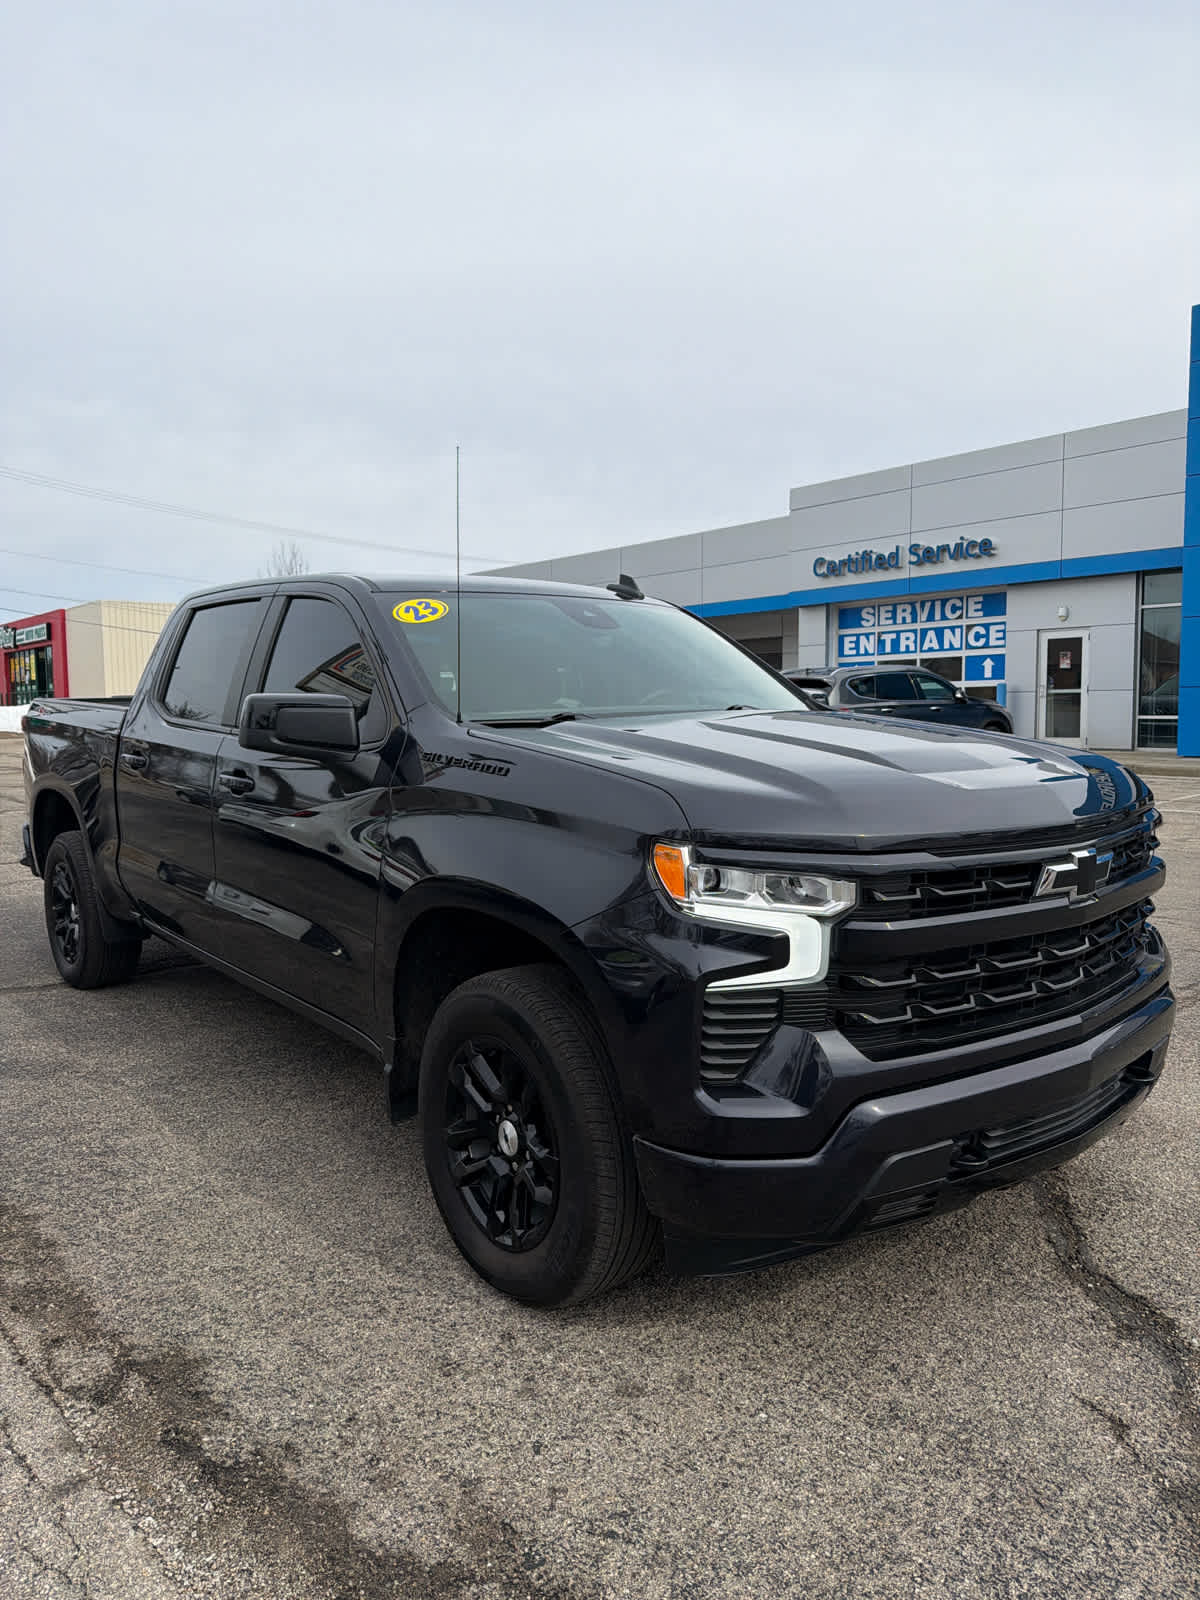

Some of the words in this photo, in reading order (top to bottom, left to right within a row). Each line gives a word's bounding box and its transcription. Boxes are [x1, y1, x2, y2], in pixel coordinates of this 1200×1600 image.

[813, 545, 900, 578] Certified
[908, 536, 993, 566] Service
[404, 600, 439, 621] 23
[860, 596, 984, 628] SERVICE
[843, 624, 1006, 656] ENTRANCE
[422, 752, 511, 777] SILVERADO
